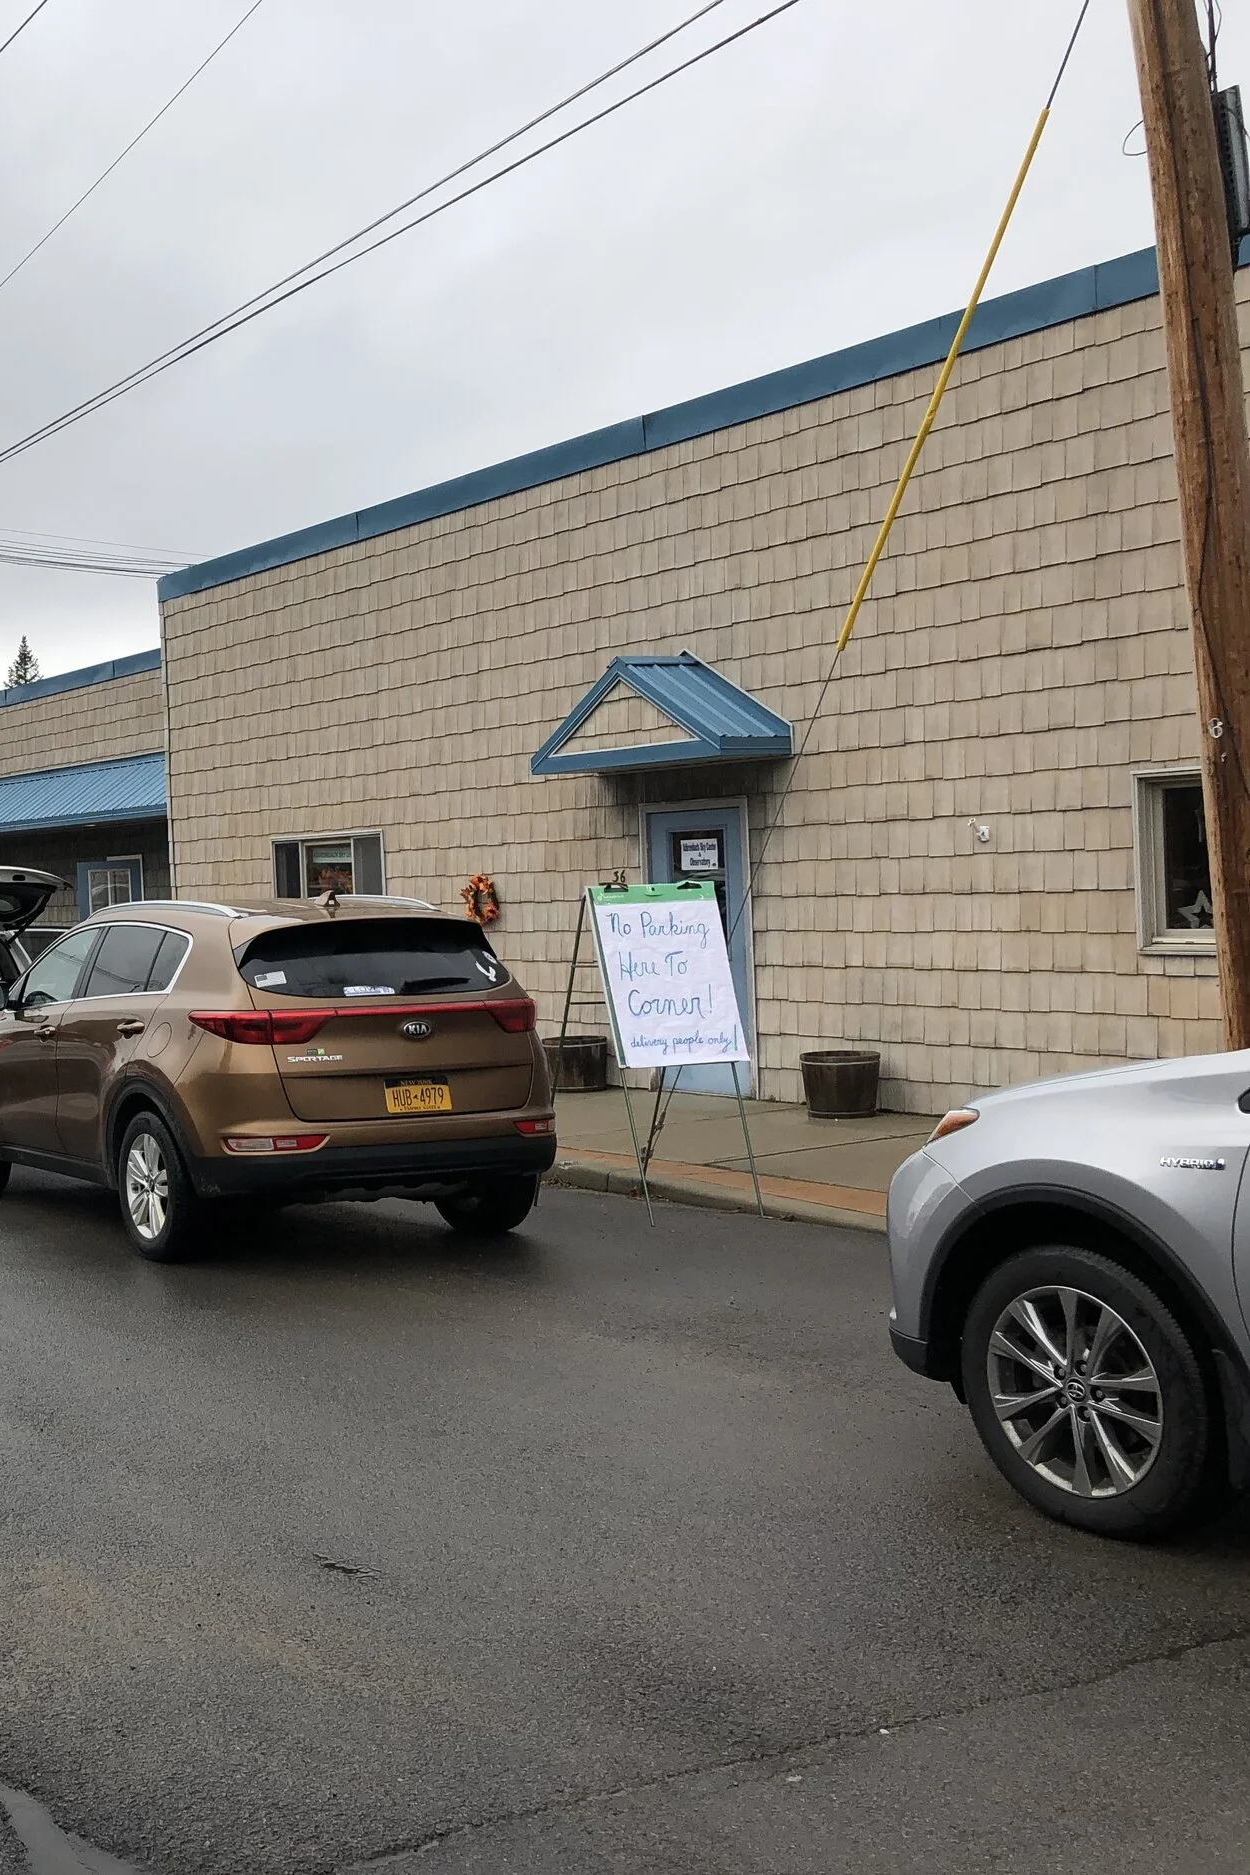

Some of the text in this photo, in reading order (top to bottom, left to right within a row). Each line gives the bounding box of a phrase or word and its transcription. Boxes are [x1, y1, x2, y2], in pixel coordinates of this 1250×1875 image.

[612, 869, 626, 883] 36
[605, 911, 710, 949] No Parking
[618, 950, 689, 981] Here To
[628, 983, 713, 1019] Corner!
[408, 1024, 427, 1035] KIA
[630, 1034, 668, 1056] delivery
[672, 1029, 704, 1053] people
[287, 1054, 343, 1063] SPORTAGE
[1160, 1157, 1214, 1169] HYBRID
